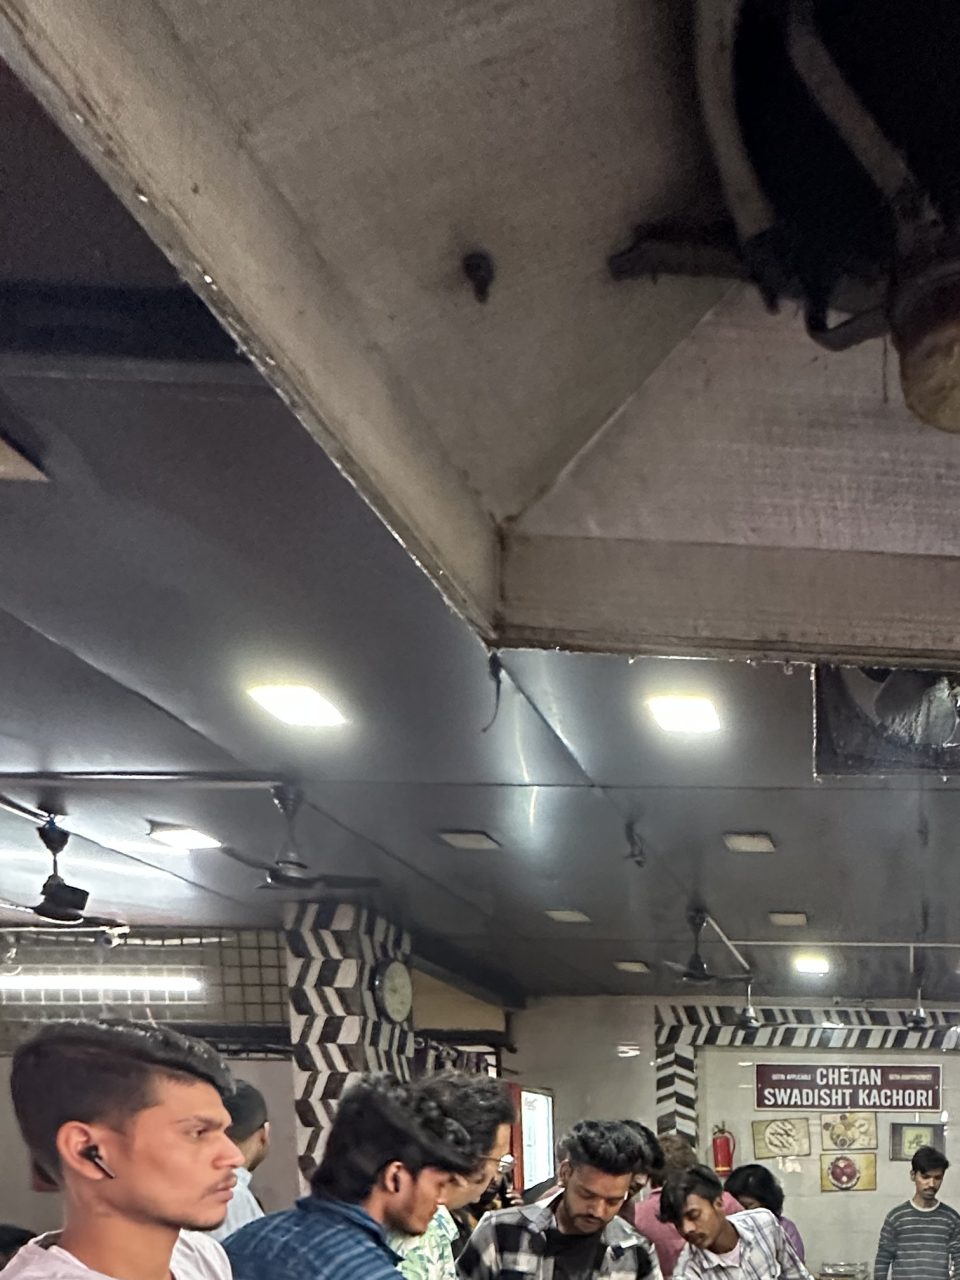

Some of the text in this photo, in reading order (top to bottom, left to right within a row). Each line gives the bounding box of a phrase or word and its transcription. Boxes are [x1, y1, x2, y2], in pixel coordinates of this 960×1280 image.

[816, 1068, 882, 1086] CHETAN
[764, 1088, 933, 1107] SWADISHT KACHORI
